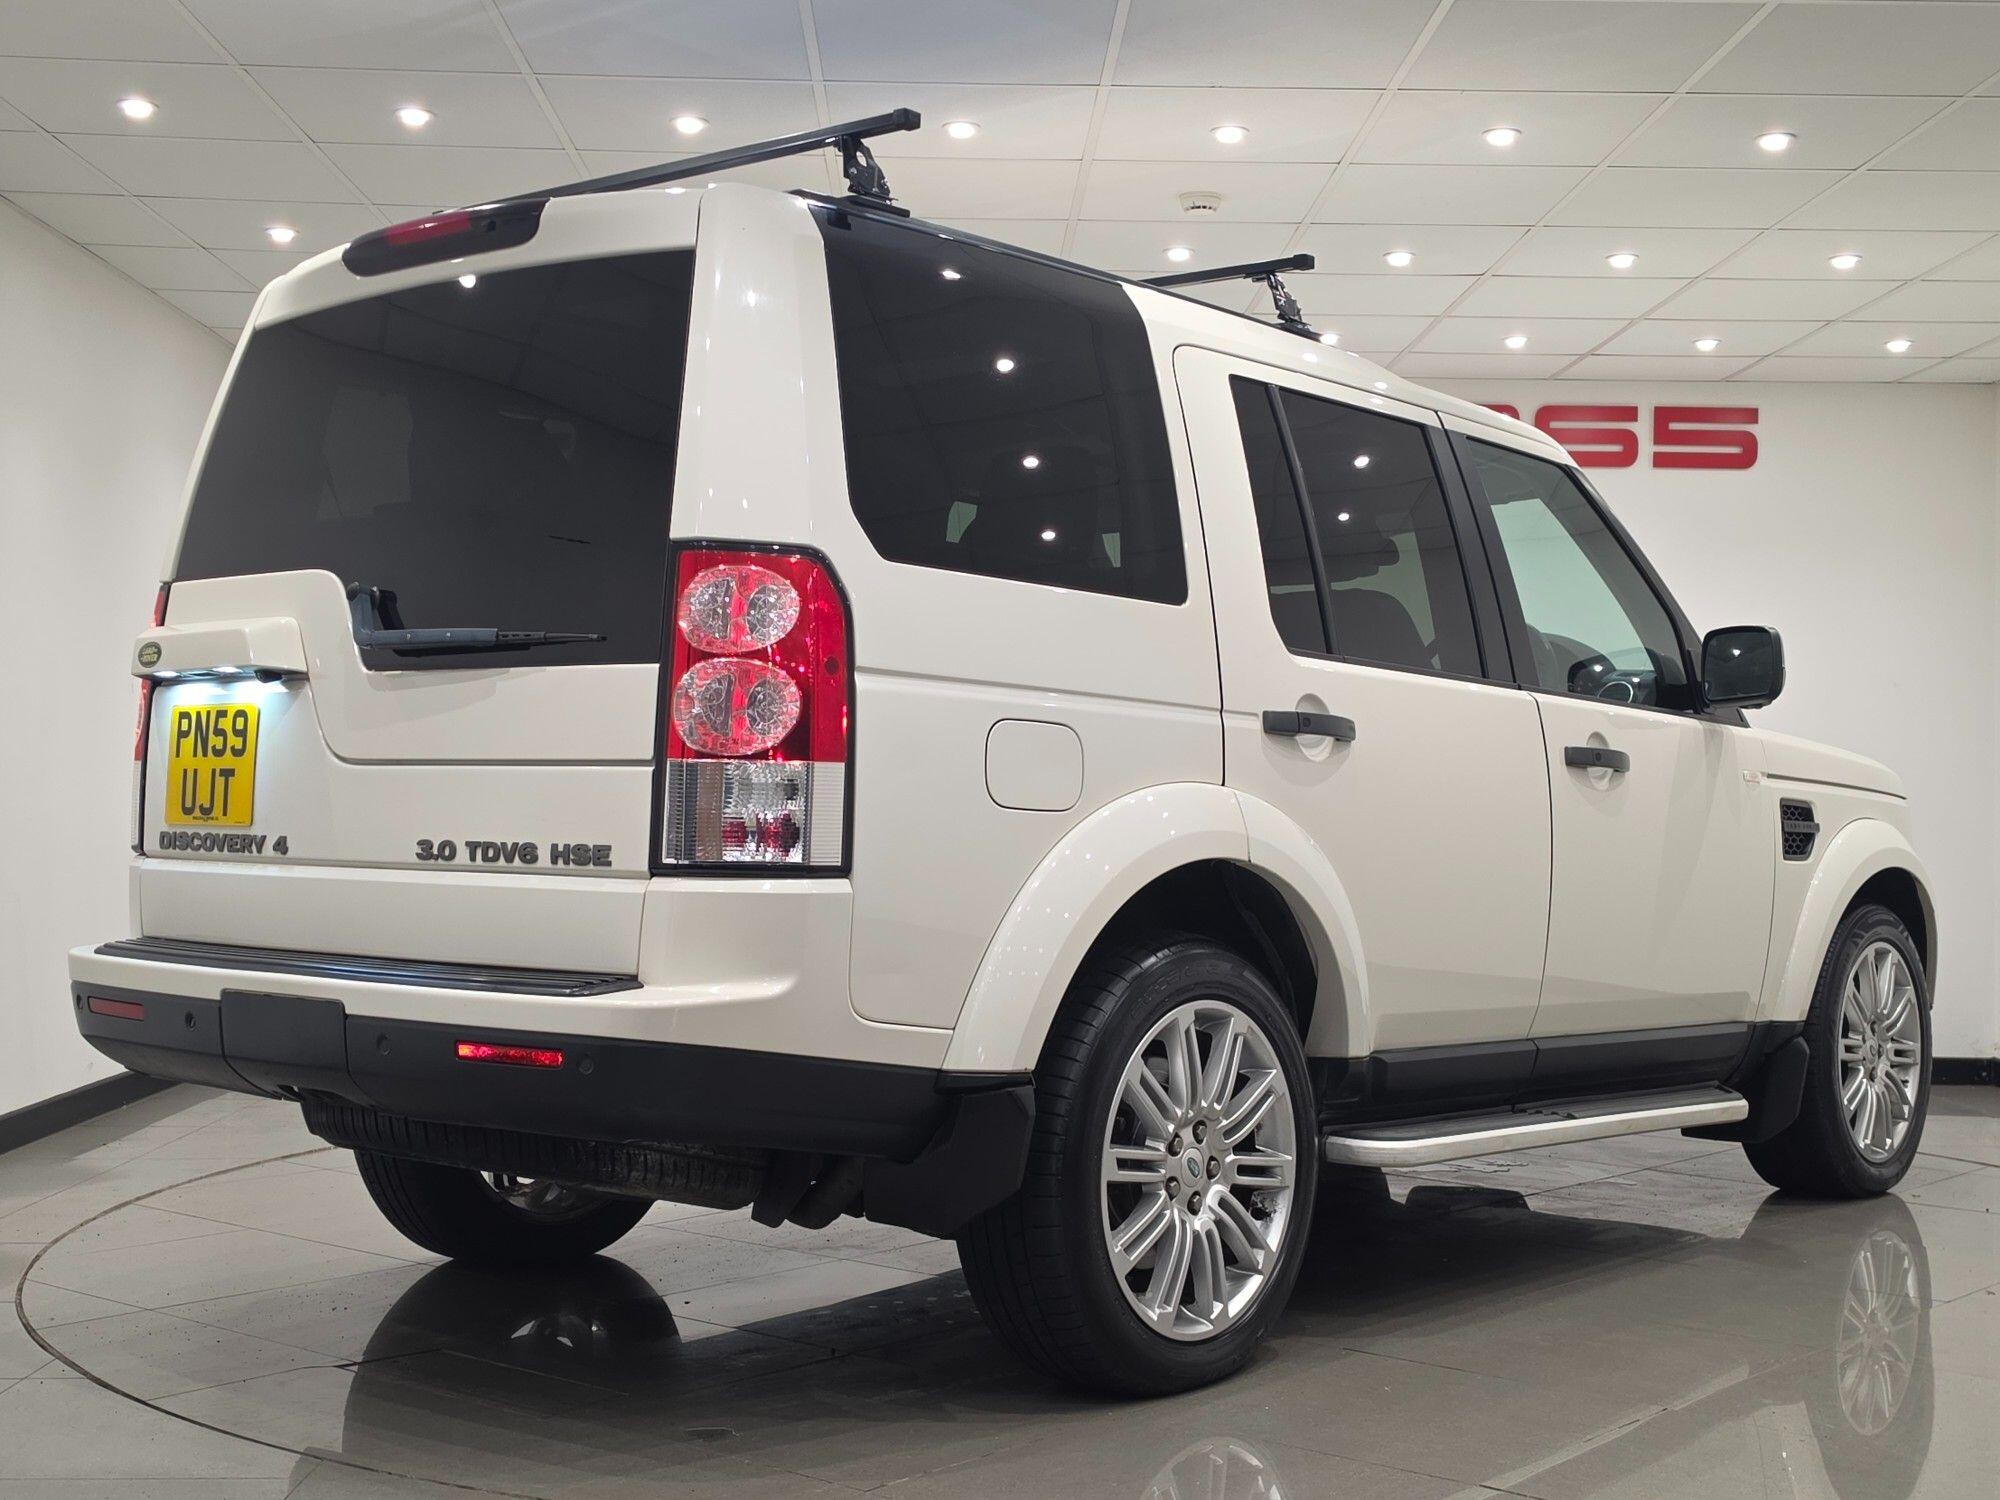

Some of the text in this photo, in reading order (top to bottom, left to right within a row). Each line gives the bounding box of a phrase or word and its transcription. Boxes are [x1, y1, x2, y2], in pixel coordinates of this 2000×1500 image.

[175, 709, 249, 758] PN59
[181, 768, 236, 816] UJT
[159, 831, 289, 856] DISCOVERY 4
[415, 839, 612, 867] 3.0 TDV6 HSE
